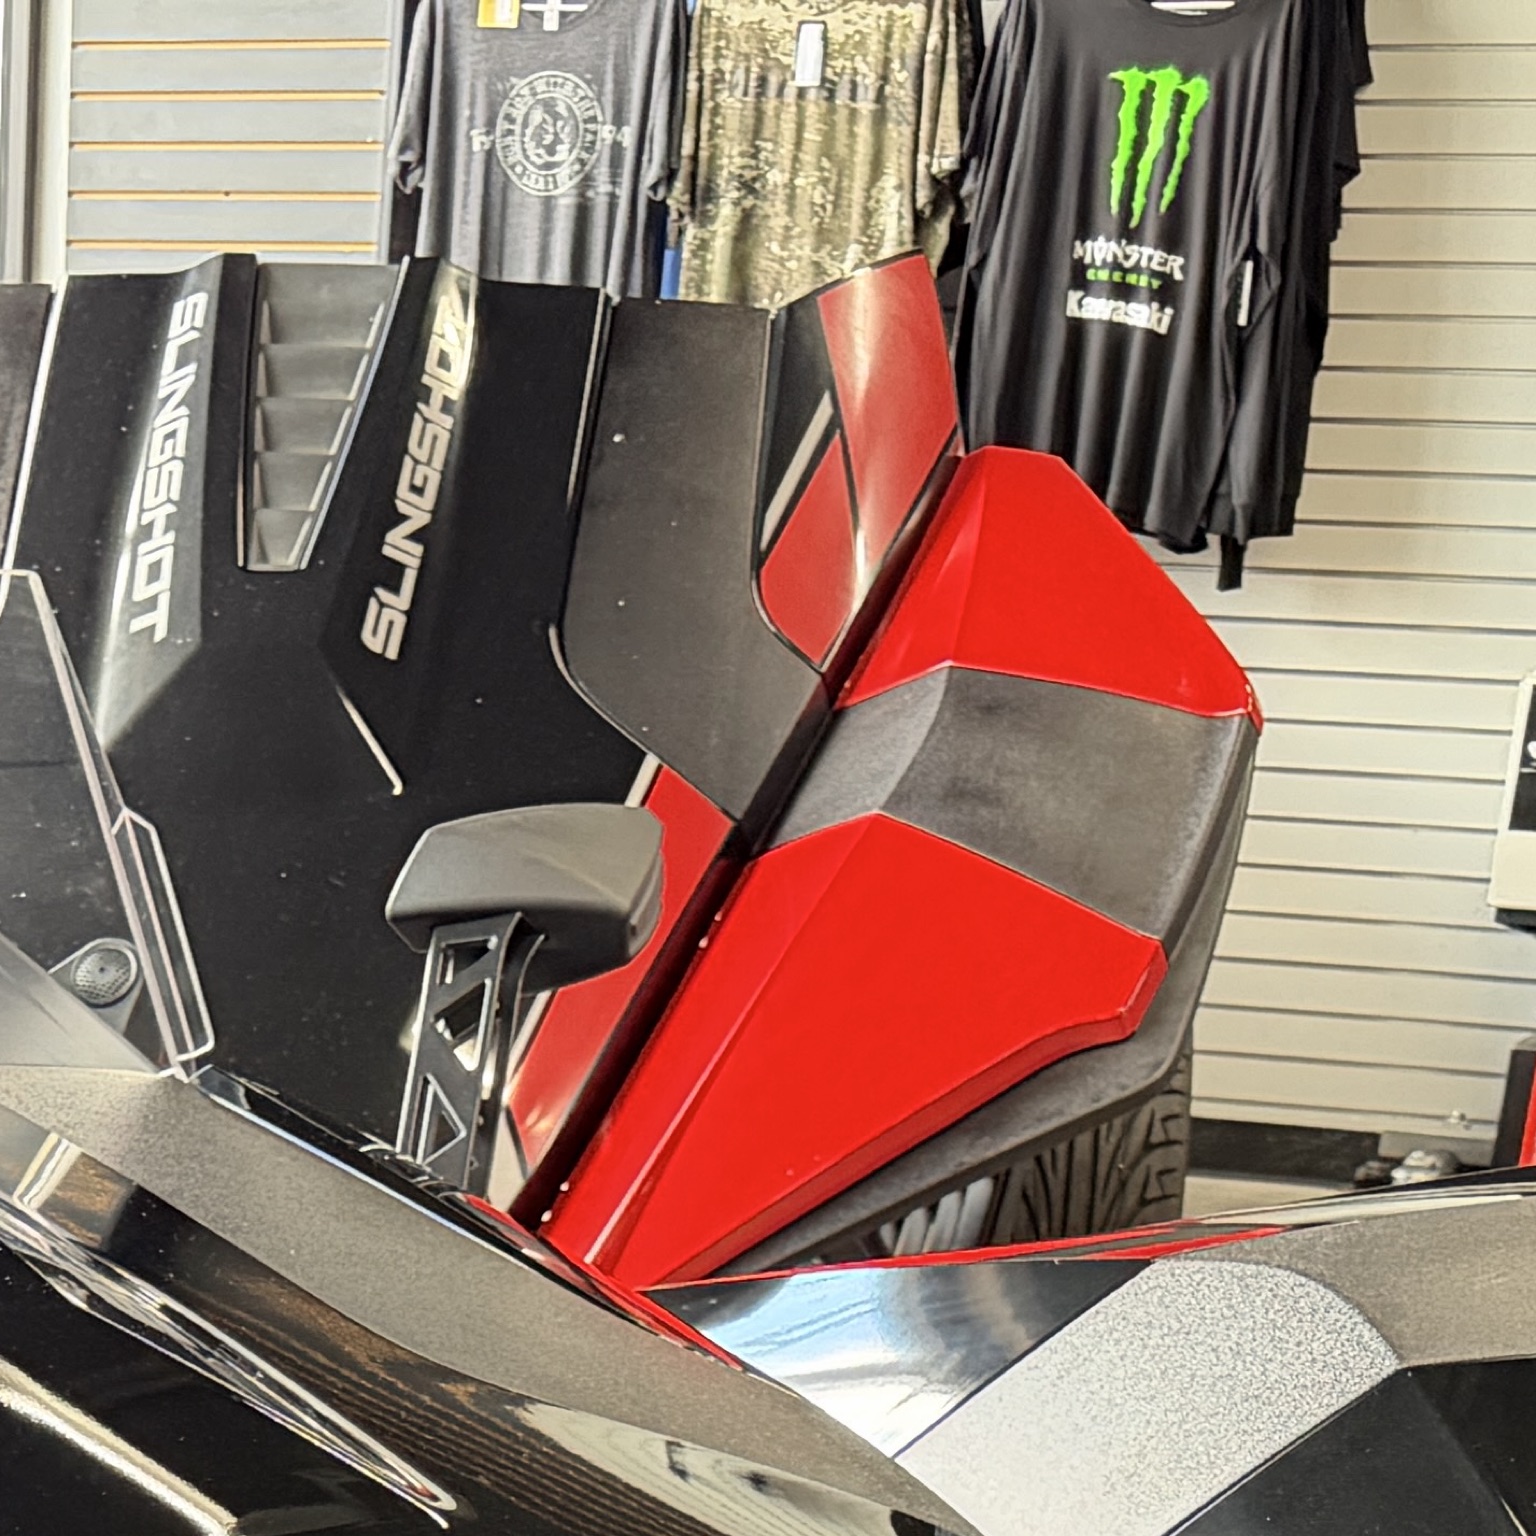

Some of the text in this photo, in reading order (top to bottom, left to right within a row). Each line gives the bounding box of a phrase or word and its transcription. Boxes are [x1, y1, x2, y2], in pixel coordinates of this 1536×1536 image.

[1072, 235, 1185, 281] MONSTER
[1086, 268, 1162, 290] ENERGY
[1066, 289, 1174, 335] Kawasaki
[128, 291, 209, 643] SLINGSHOT
[360, 293, 471, 661] SLINGSHOT
